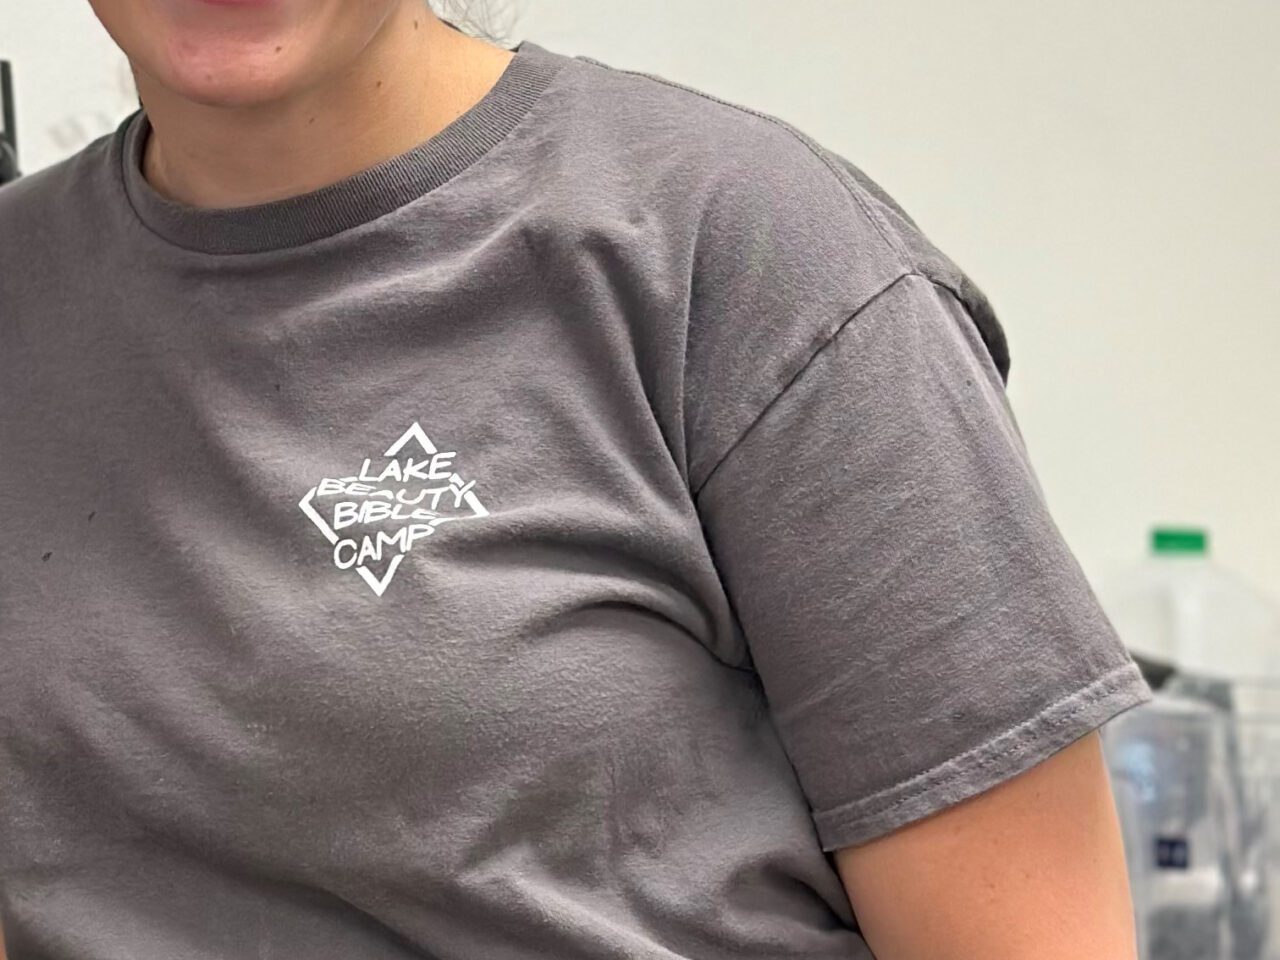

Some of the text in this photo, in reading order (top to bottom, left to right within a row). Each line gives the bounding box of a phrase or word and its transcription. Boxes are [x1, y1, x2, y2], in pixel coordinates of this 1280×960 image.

[359, 451, 457, 483] LAKE
[317, 478, 477, 510] BEAUTY
[333, 500, 442, 530] BIBLE
[333, 524, 436, 570] CAMP
